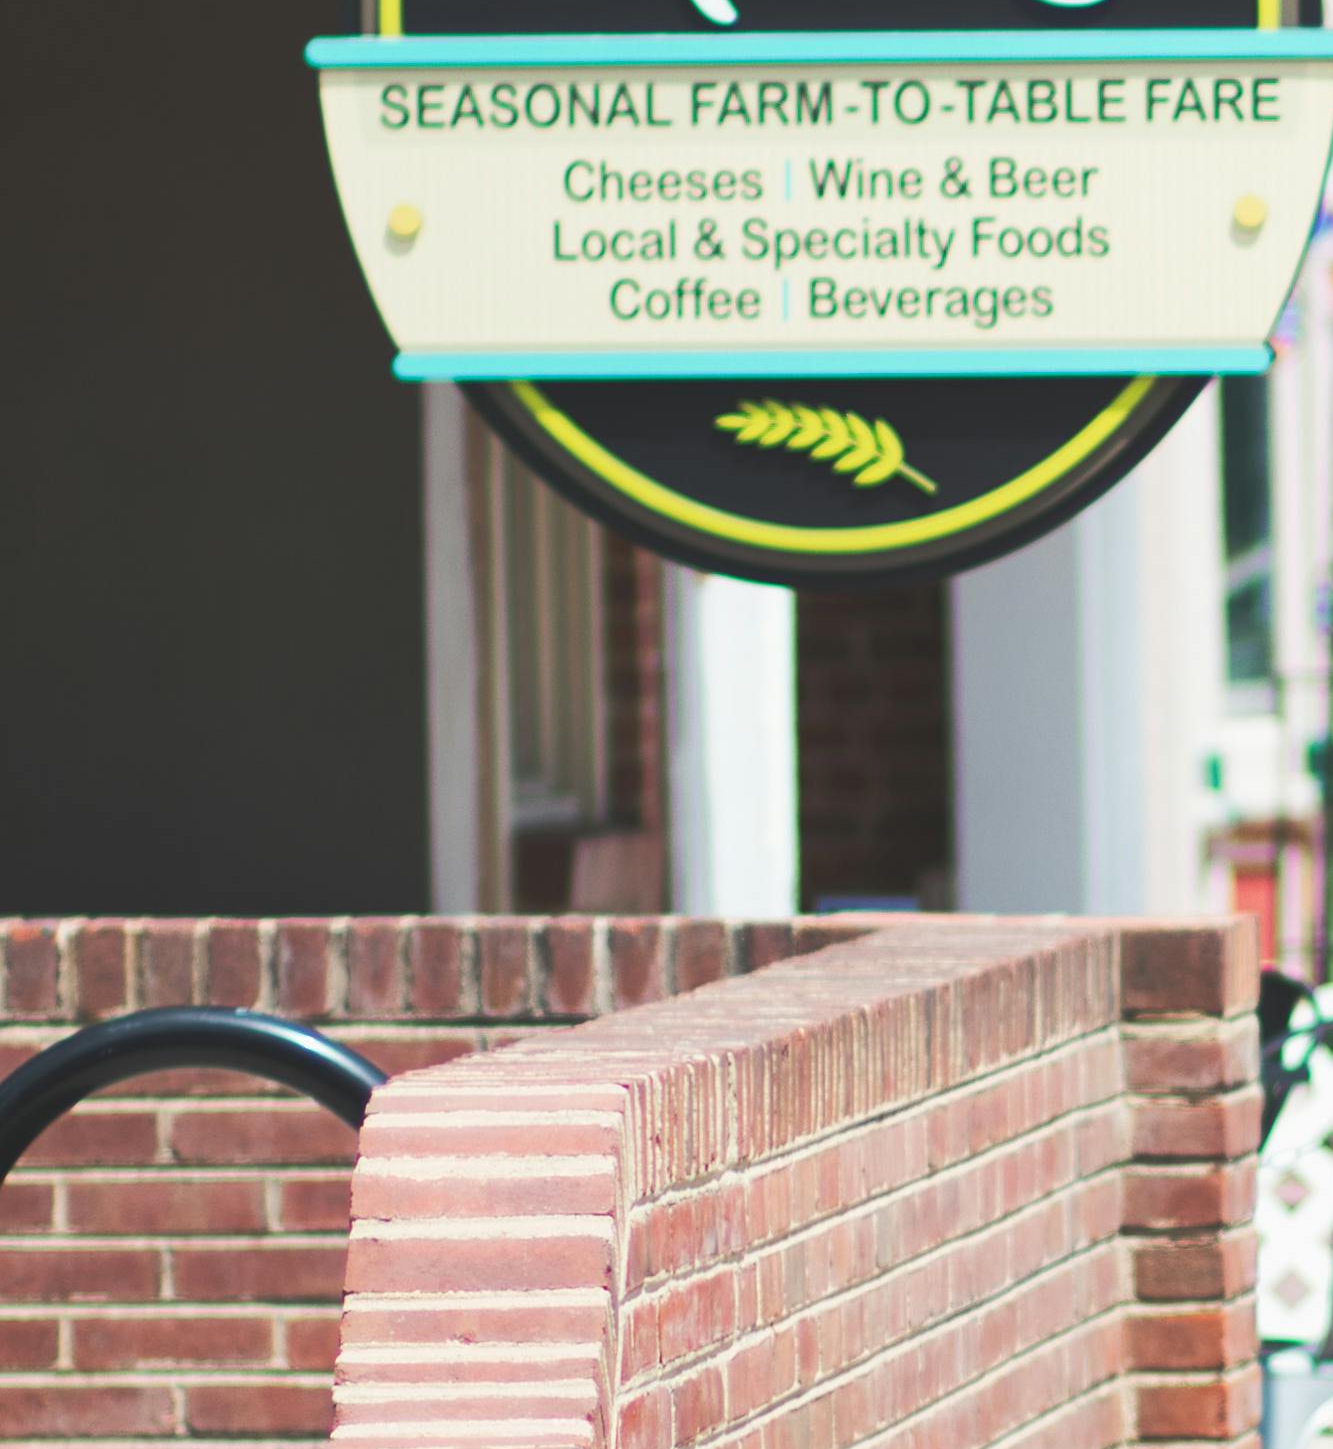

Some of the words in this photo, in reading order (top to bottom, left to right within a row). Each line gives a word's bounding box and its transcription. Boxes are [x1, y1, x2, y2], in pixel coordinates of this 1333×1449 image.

[379, 84, 673, 131] SEASONAL
[1145, 77, 1282, 124] FARE
[562, 160, 764, 203] Cheeses
[808, 158, 924, 201] Wine
[938, 158, 972, 200] &
[988, 157, 1098, 200] Beer
[552, 221, 678, 263] Local
[692, 219, 724, 261] &
[741, 219, 956, 271] Specialty
[970, 216, 1111, 259] Foods
[608, 279, 763, 322] Coffee
[807, 278, 1055, 329] Beverages
